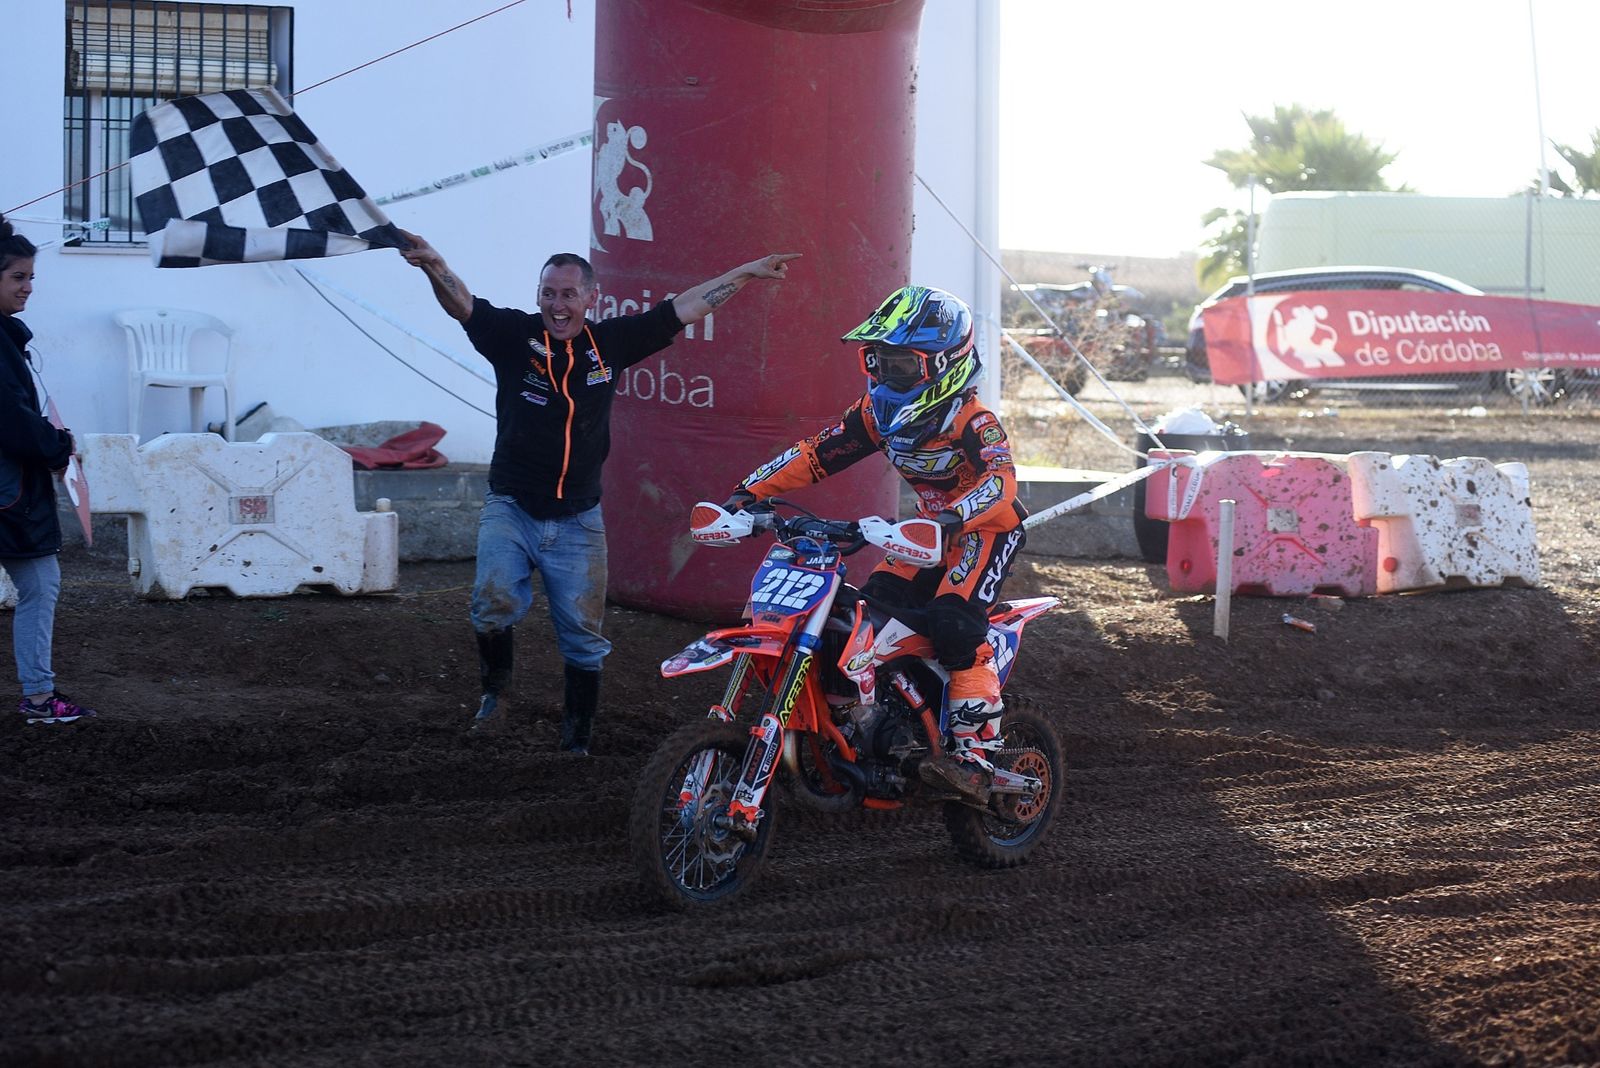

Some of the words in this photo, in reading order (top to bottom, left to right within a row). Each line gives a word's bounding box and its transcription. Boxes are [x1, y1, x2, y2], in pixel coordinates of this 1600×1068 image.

[1347, 310, 1491, 340] Diputación
[1354, 342, 1391, 366] de
[1396, 338, 1502, 364] Córdoba
[751, 568, 826, 610] 212
